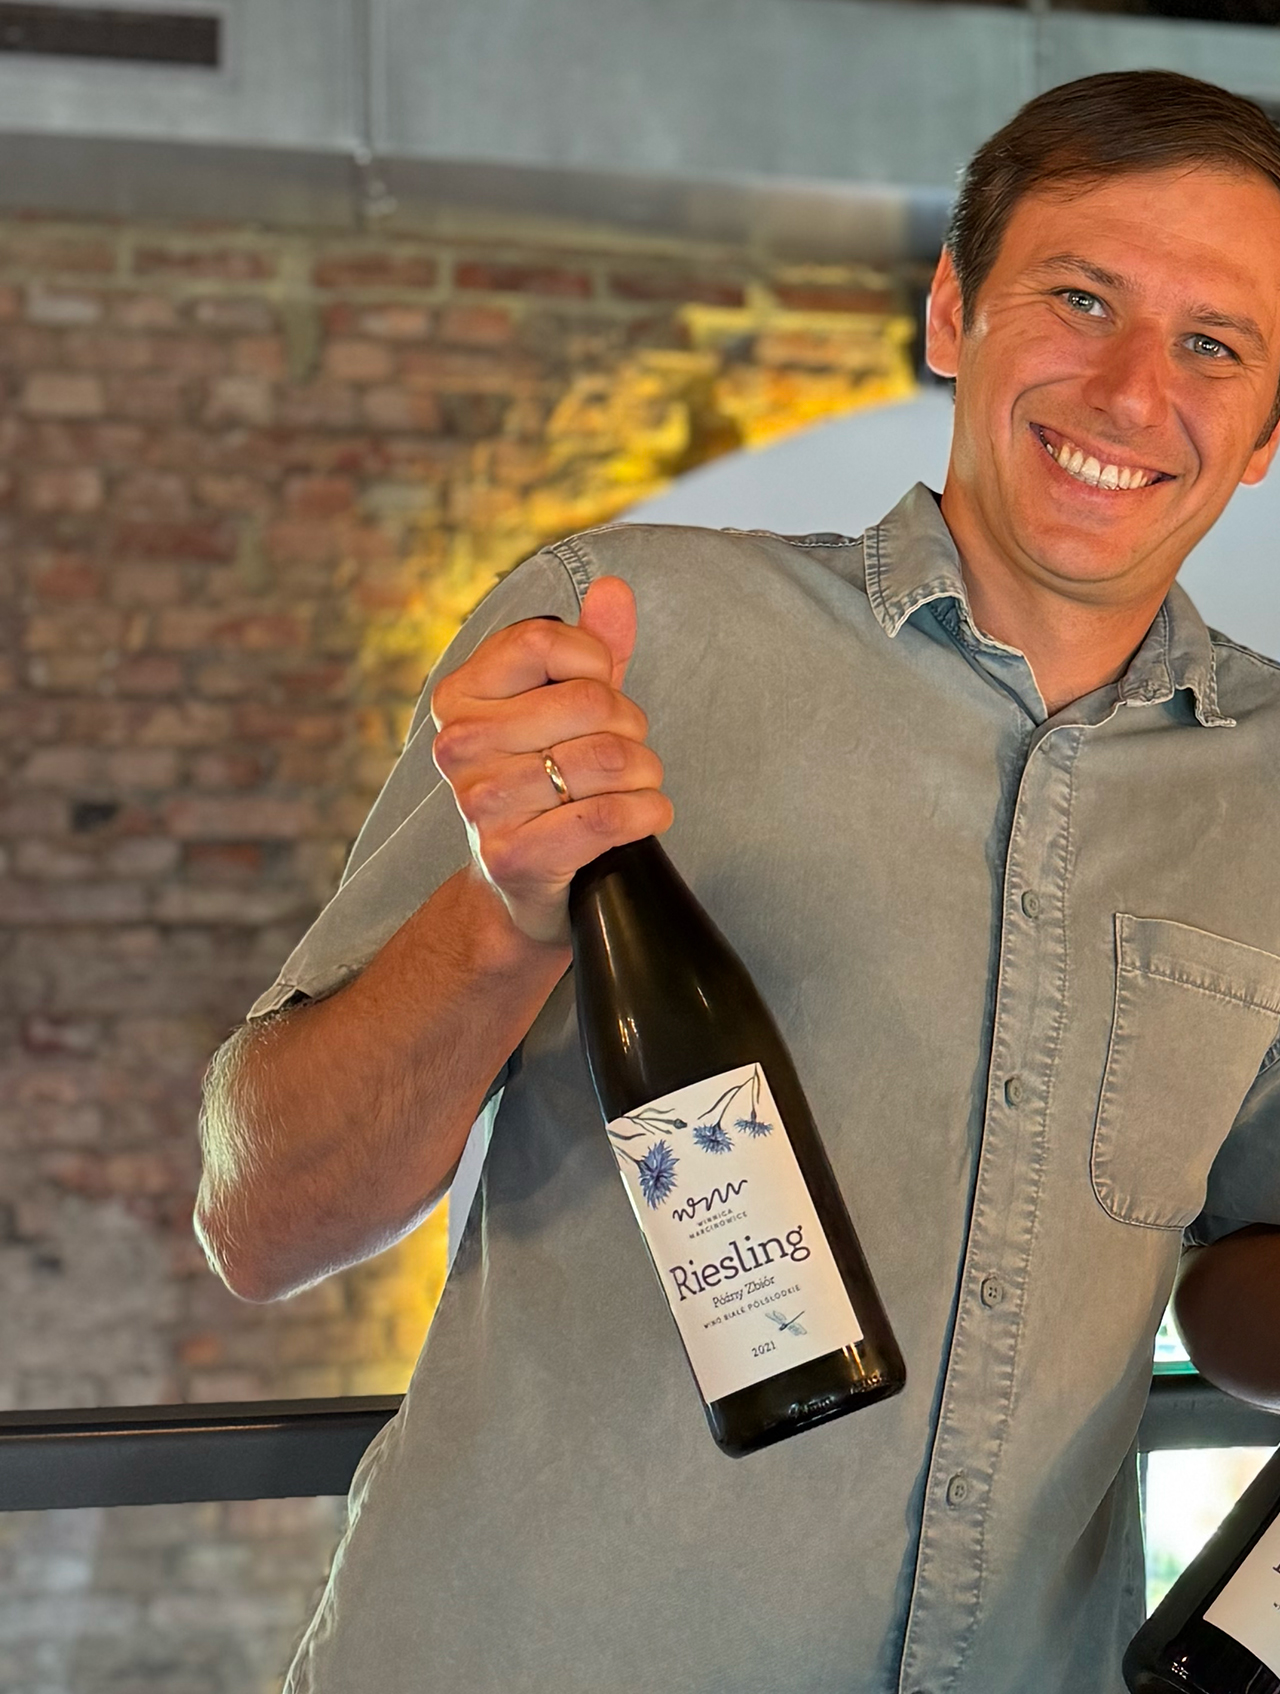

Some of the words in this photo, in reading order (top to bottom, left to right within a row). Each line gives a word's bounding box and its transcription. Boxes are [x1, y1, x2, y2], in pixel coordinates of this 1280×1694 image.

[669, 1224, 811, 1302] Riesling
[744, 1274, 776, 1297] Zbiór
[751, 1340, 777, 1358] 2021
